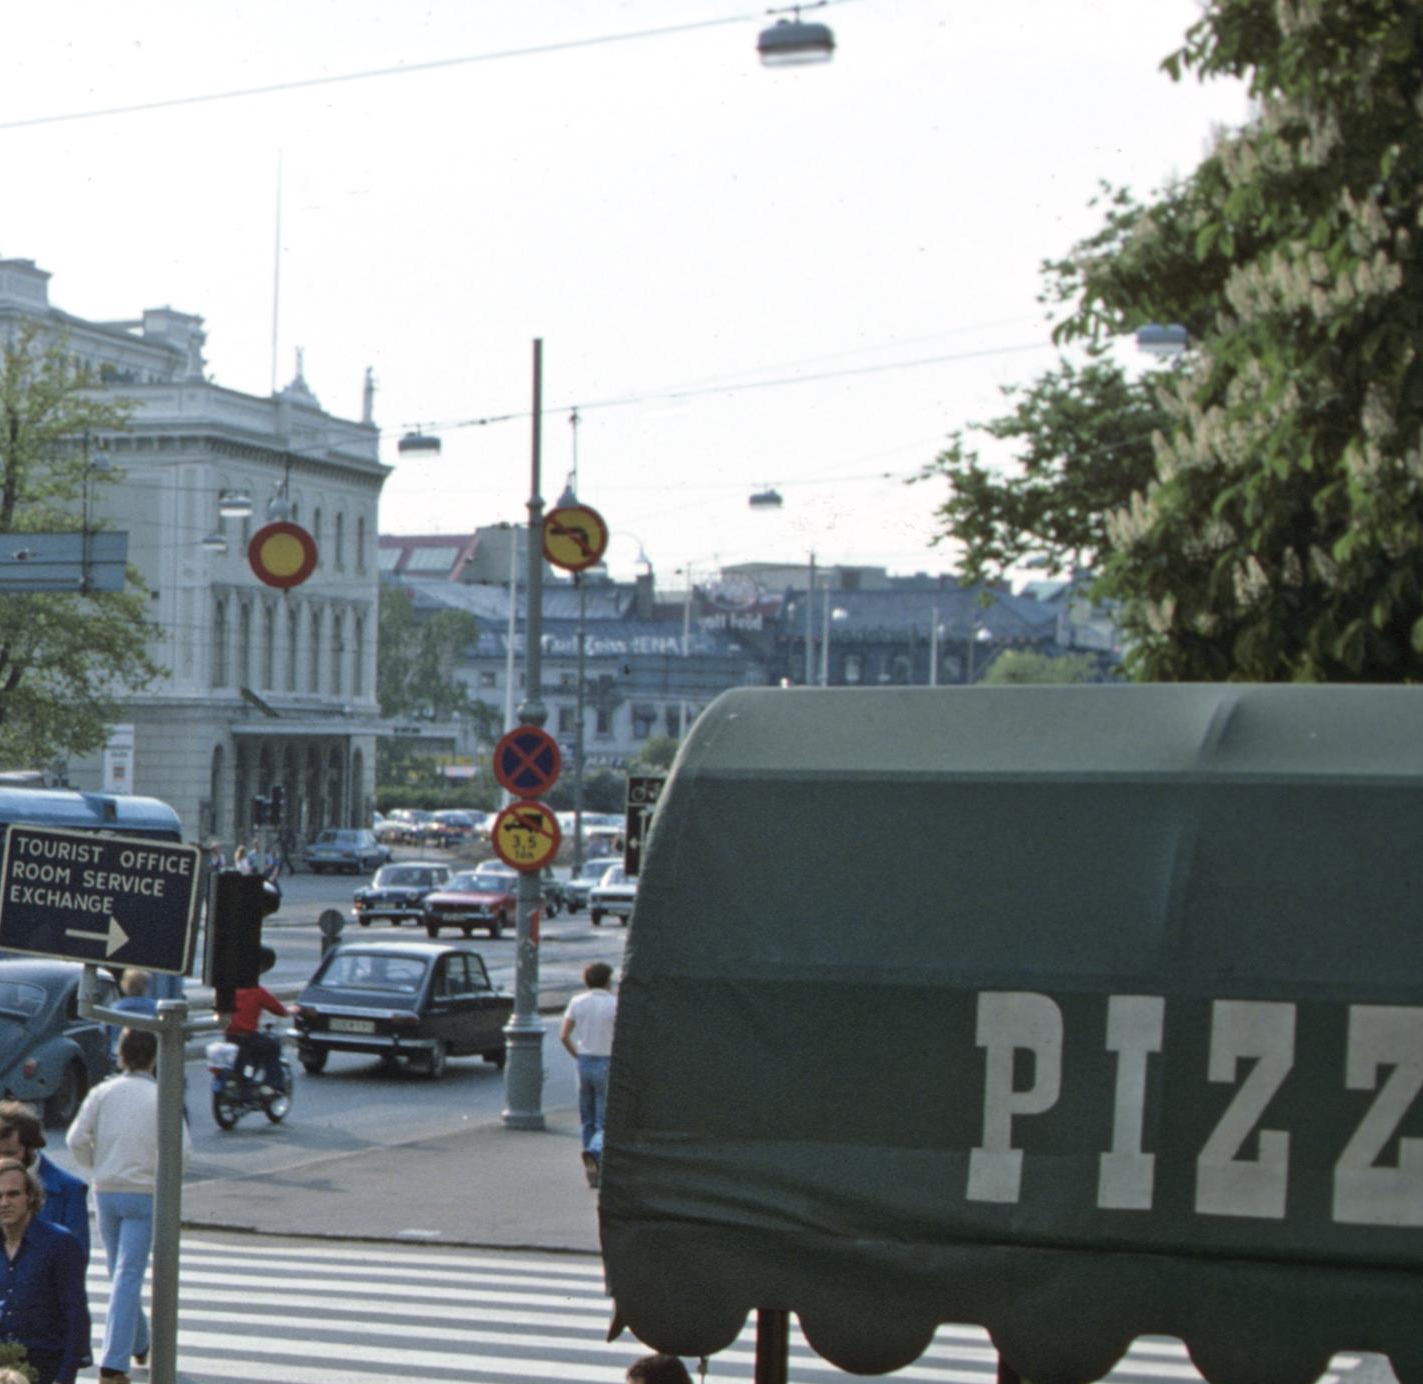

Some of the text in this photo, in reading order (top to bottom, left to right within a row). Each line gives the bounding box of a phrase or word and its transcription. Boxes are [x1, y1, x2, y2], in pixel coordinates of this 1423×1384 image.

[17, 836, 191, 875] TOURIST OFFICE
[512, 834, 537, 850] 3,5
[12, 860, 166, 897] ROOM SERVICE
[10, 885, 114, 915] EXCHANGE
[965, 990, 1423, 1227] PIZZ
